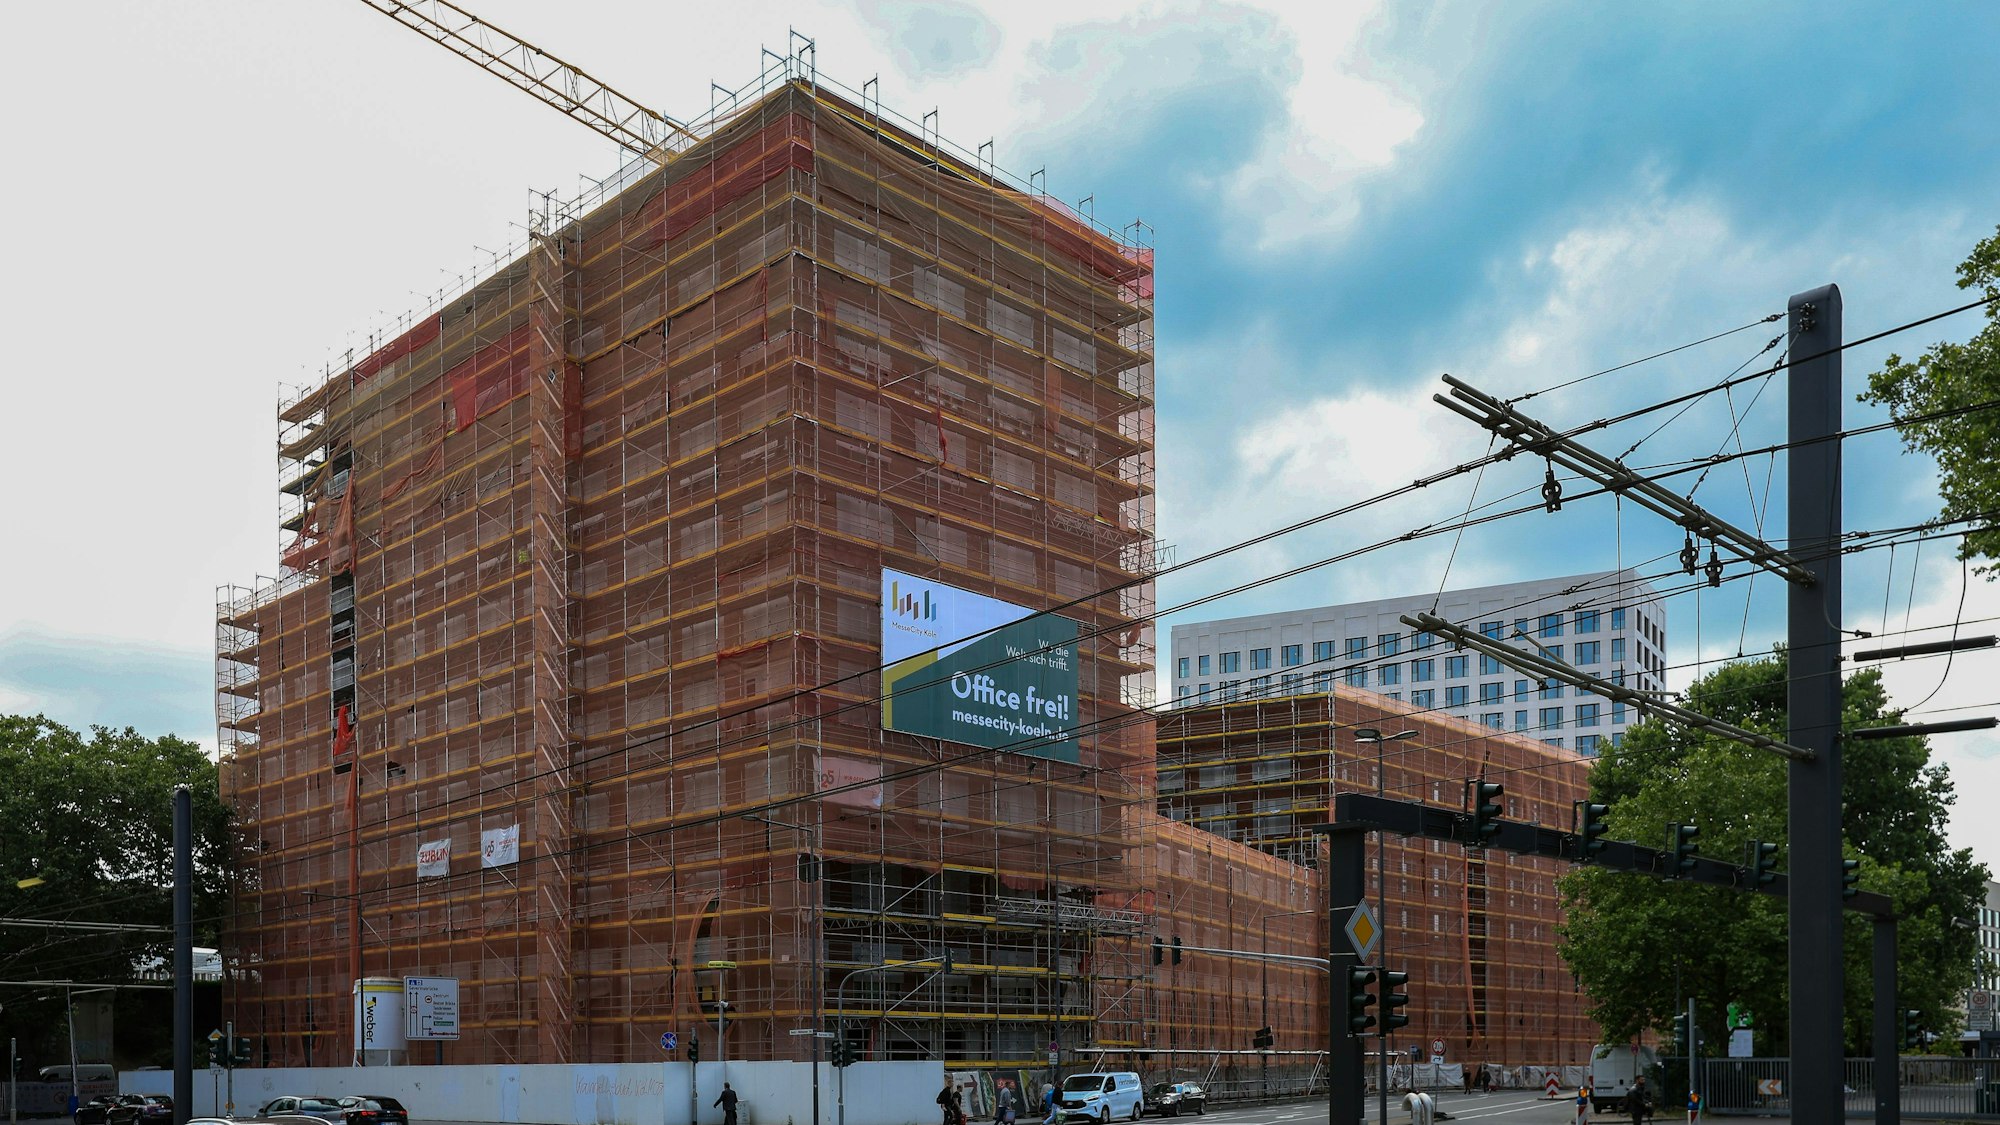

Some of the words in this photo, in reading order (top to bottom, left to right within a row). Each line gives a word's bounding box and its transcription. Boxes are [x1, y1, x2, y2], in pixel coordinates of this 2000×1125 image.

[891, 621, 923, 637] MesseCity
[924, 629, 937, 638] Köln
[1005, 645, 1027, 662] Welt
[1029, 652, 1047, 666] sich
[1048, 658, 1070, 672] trifft.
[1055, 644, 1069, 658] die
[951, 670, 1021, 711] Office
[1025, 685, 1070, 721] frei!
[952, 708, 1069, 743] messecity-koeln.de
[366, 1005, 376, 1043] weber
